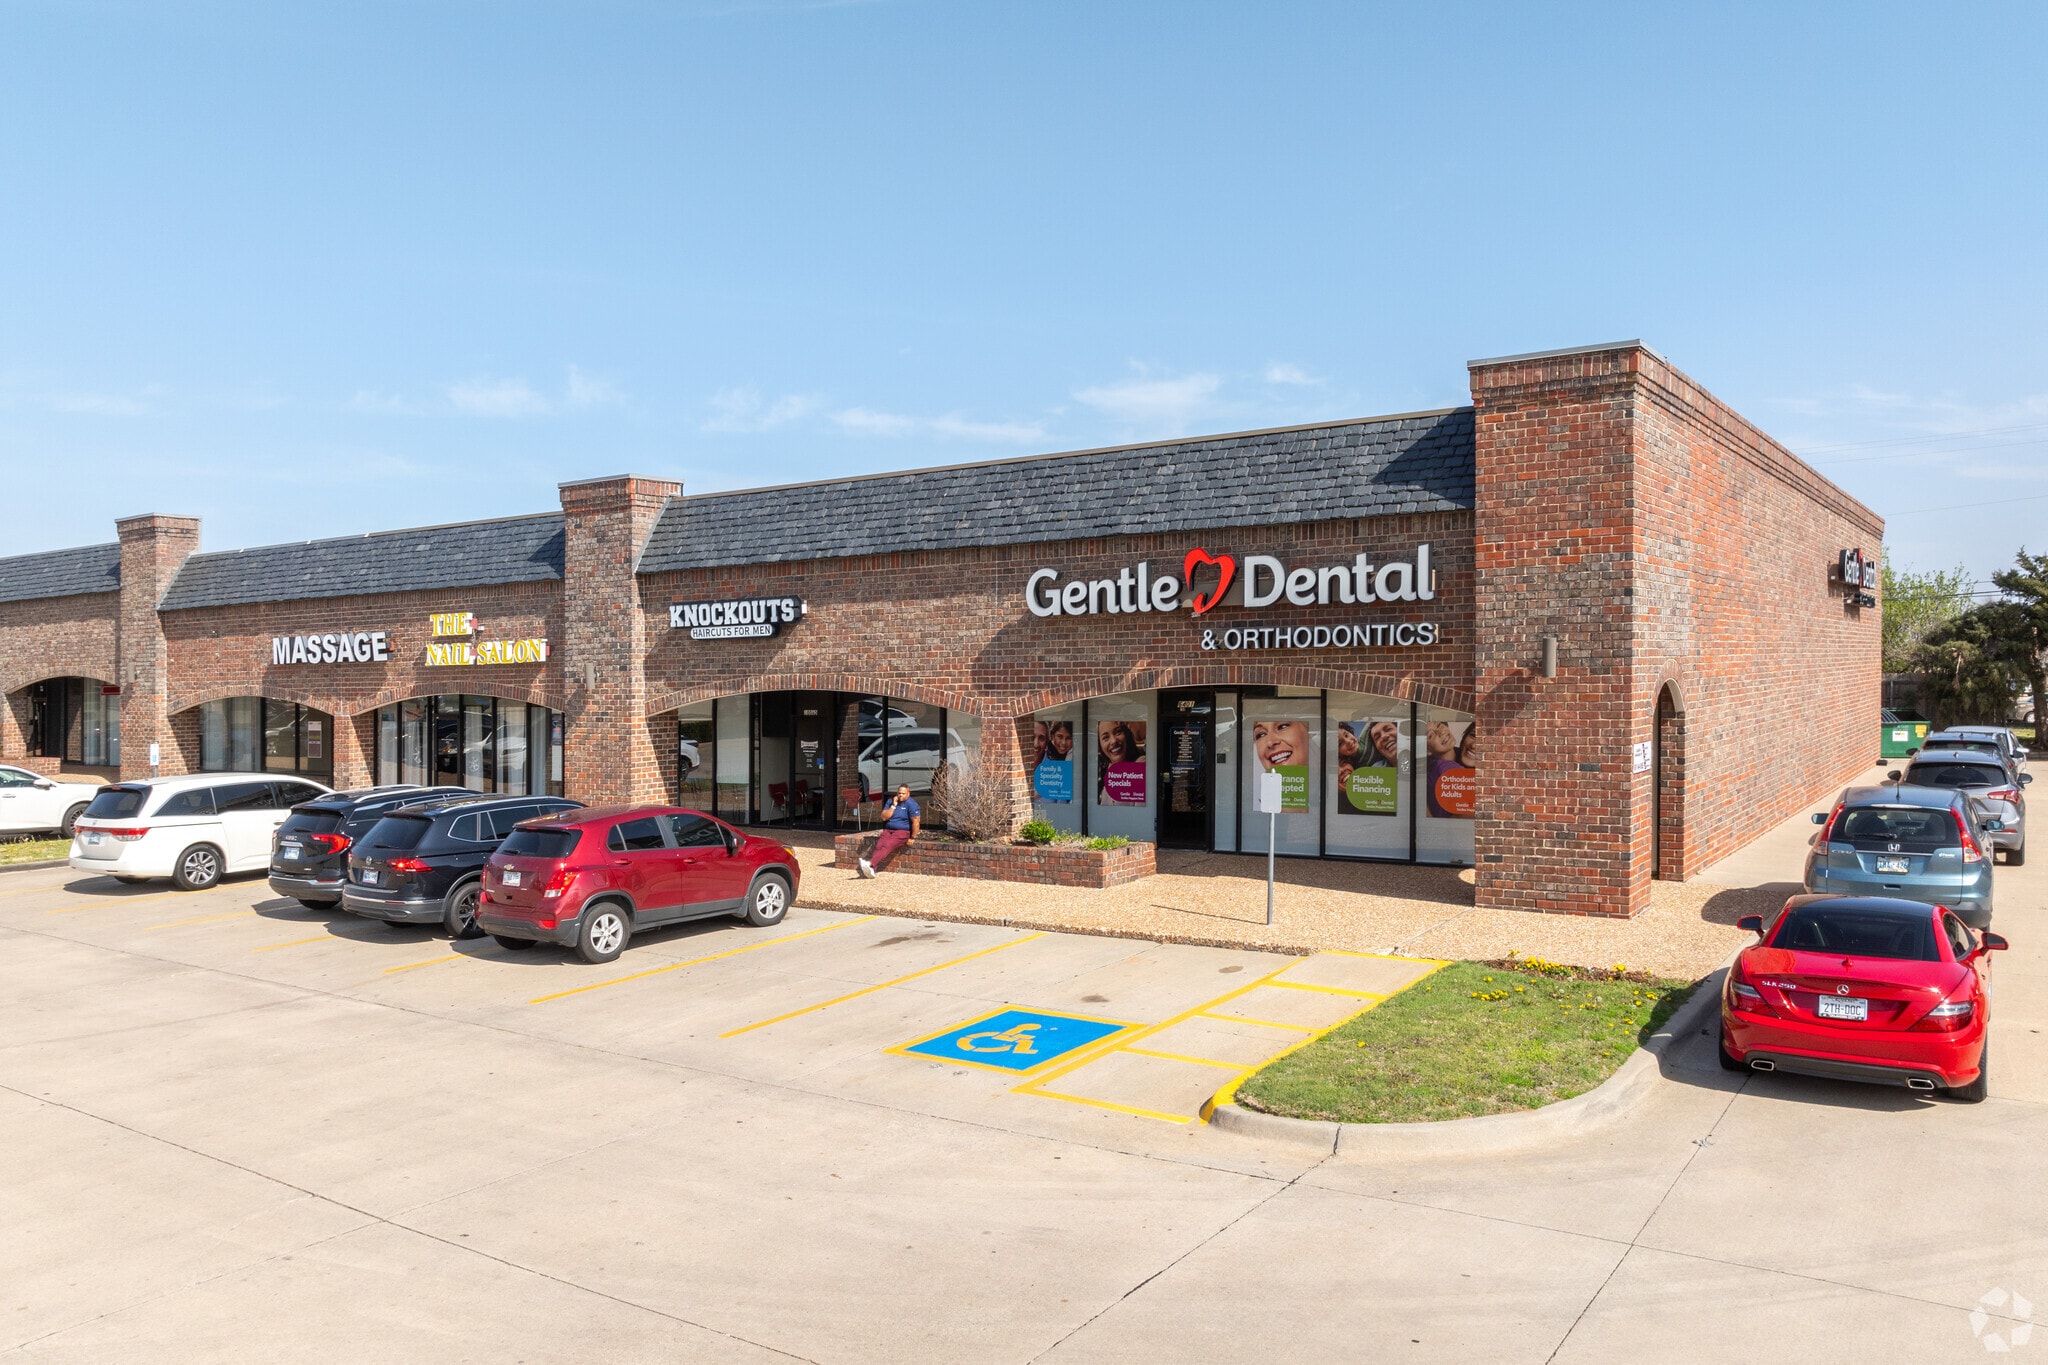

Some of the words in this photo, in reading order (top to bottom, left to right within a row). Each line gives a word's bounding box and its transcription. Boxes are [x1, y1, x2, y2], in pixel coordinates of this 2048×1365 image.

[1025, 561, 1181, 617] Gentle
[1243, 544, 1436, 608] Dental
[669, 598, 795, 628] KNOCKOUTS
[429, 612, 472, 637] THE
[692, 627, 732, 638] HAIRCUTS
[734, 626, 749, 636] FOR
[752, 625, 771, 635] MEN
[1201, 629, 1218, 651] &
[1224, 623, 1436, 650] ORTHODONTICS
[272, 632, 390, 665] MASSAGE
[425, 642, 471, 667] NAIL
[476, 639, 544, 666] SALON
[1040, 765, 1057, 773] Family
[1040, 772, 1063, 780] Specialty
[1122, 772, 1144, 780] Patient
[1352, 775, 1384, 784] Flexible
[1441, 775, 1476, 783] Orthodont
[1108, 780, 1132, 788] Specials
[1281, 783, 1305, 794] pted
[1352, 784, 1391, 795] Financing
